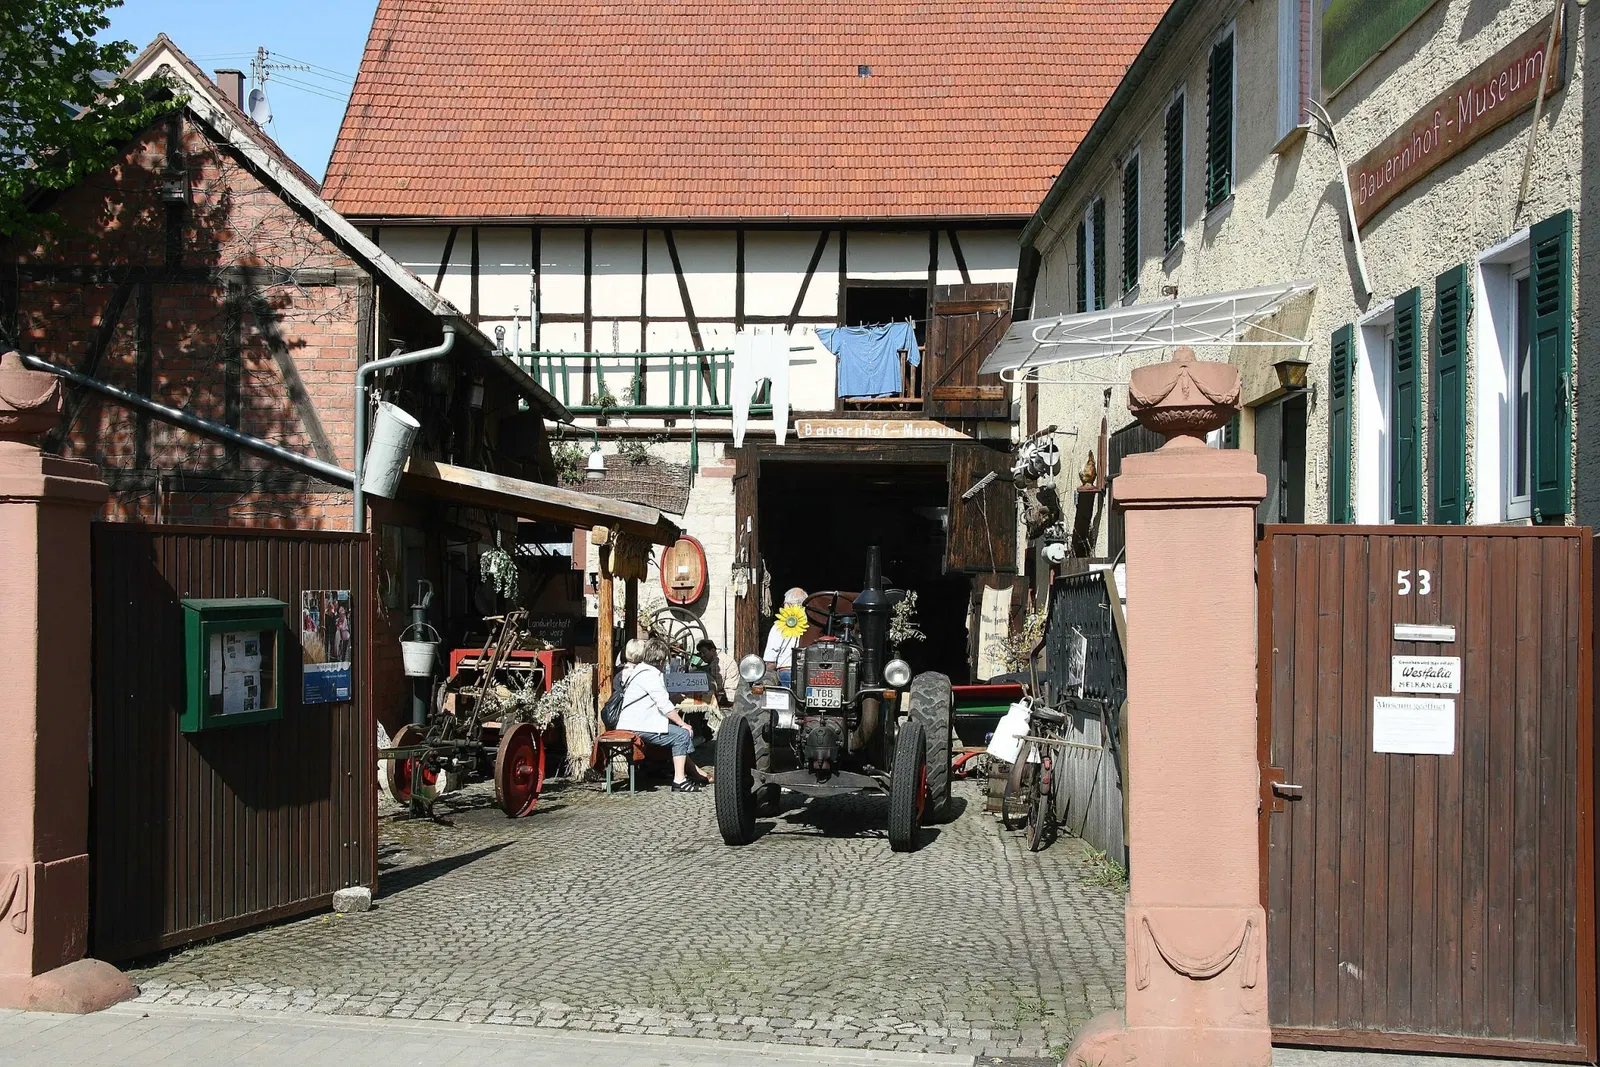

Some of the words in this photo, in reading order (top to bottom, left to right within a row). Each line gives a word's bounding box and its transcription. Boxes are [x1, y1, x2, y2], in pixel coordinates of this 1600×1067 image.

[1359, 110, 1441, 205] Bauernhof
[1457, 49, 1543, 133] Museum
[1397, 569, 1431, 595] 53
[1402, 666, 1452, 679] Westfalia
[816, 689, 833, 698] TBB
